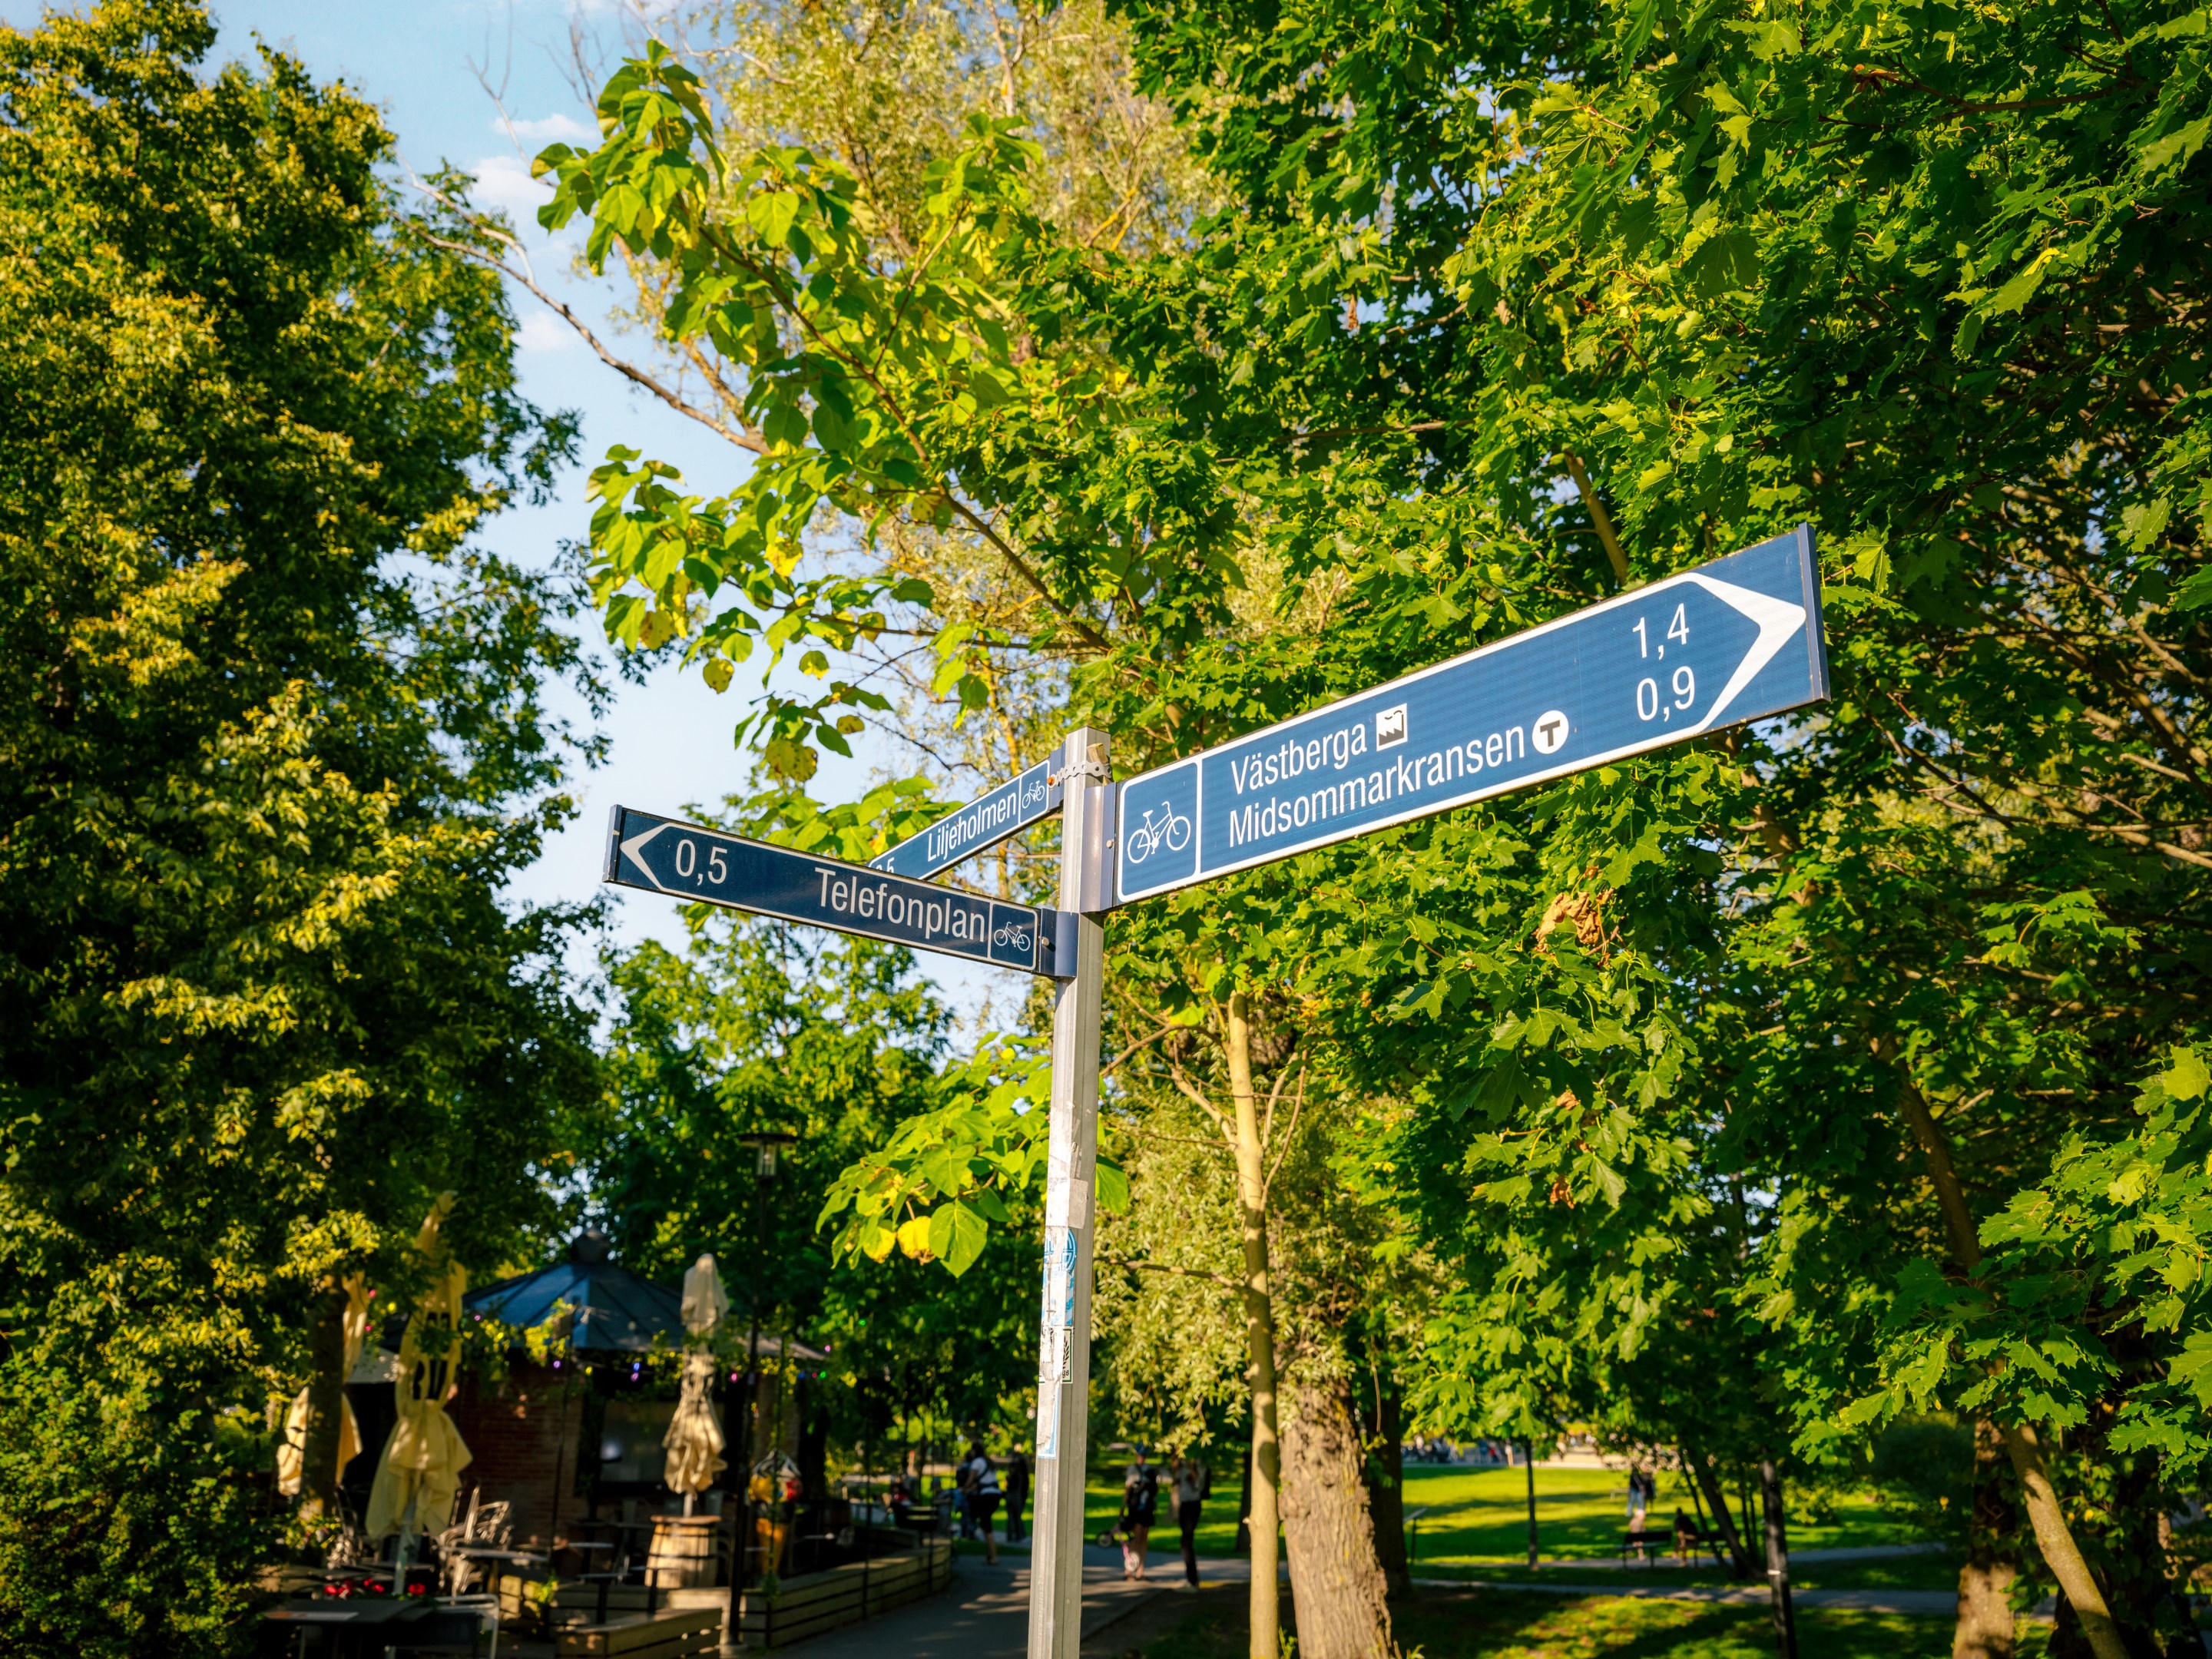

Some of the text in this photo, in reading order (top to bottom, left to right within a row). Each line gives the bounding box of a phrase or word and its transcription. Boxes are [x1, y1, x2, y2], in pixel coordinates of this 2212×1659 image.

[1229, 725, 1525, 849] Midsommarkransen
[1636, 665, 1696, 723] 0,9
[1230, 602, 1690, 796] Västberga 1,4
[675, 839, 985, 942] 0,5 Telefonplan
[927, 791, 1017, 863] Liljeholmen
